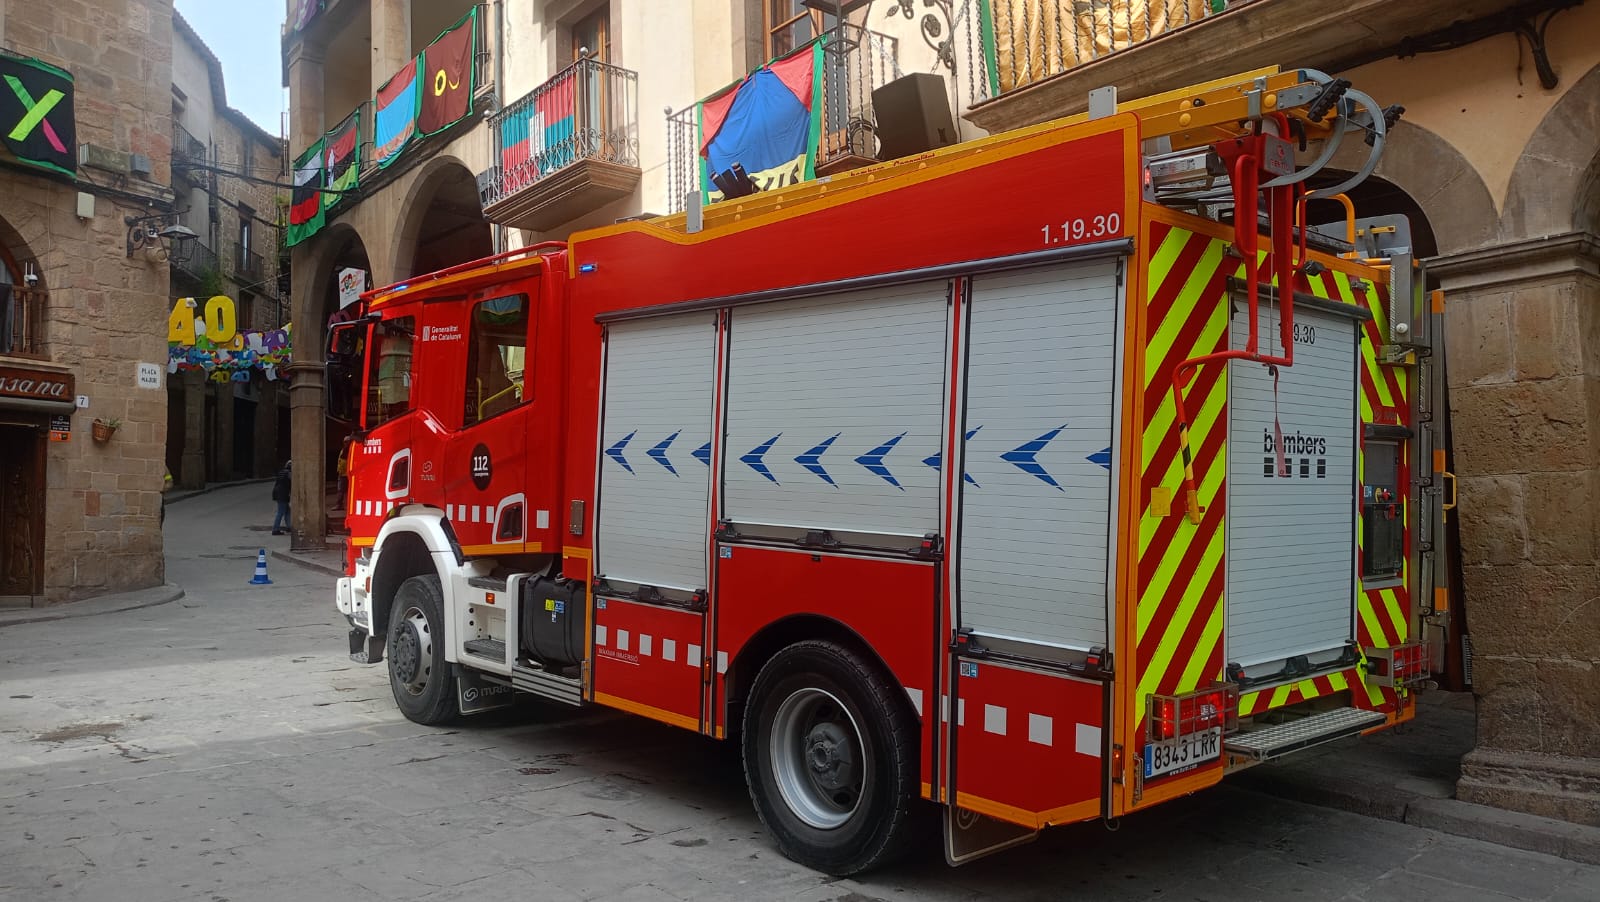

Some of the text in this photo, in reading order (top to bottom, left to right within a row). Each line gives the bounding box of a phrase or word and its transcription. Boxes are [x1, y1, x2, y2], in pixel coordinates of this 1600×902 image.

[1041, 212, 1120, 245] 1.19.30
[168, 295, 237, 346] 40
[79, 397, 85, 406] 7
[473, 455, 489, 471] 112
[1154, 731, 1216, 770] 8343 LRR
